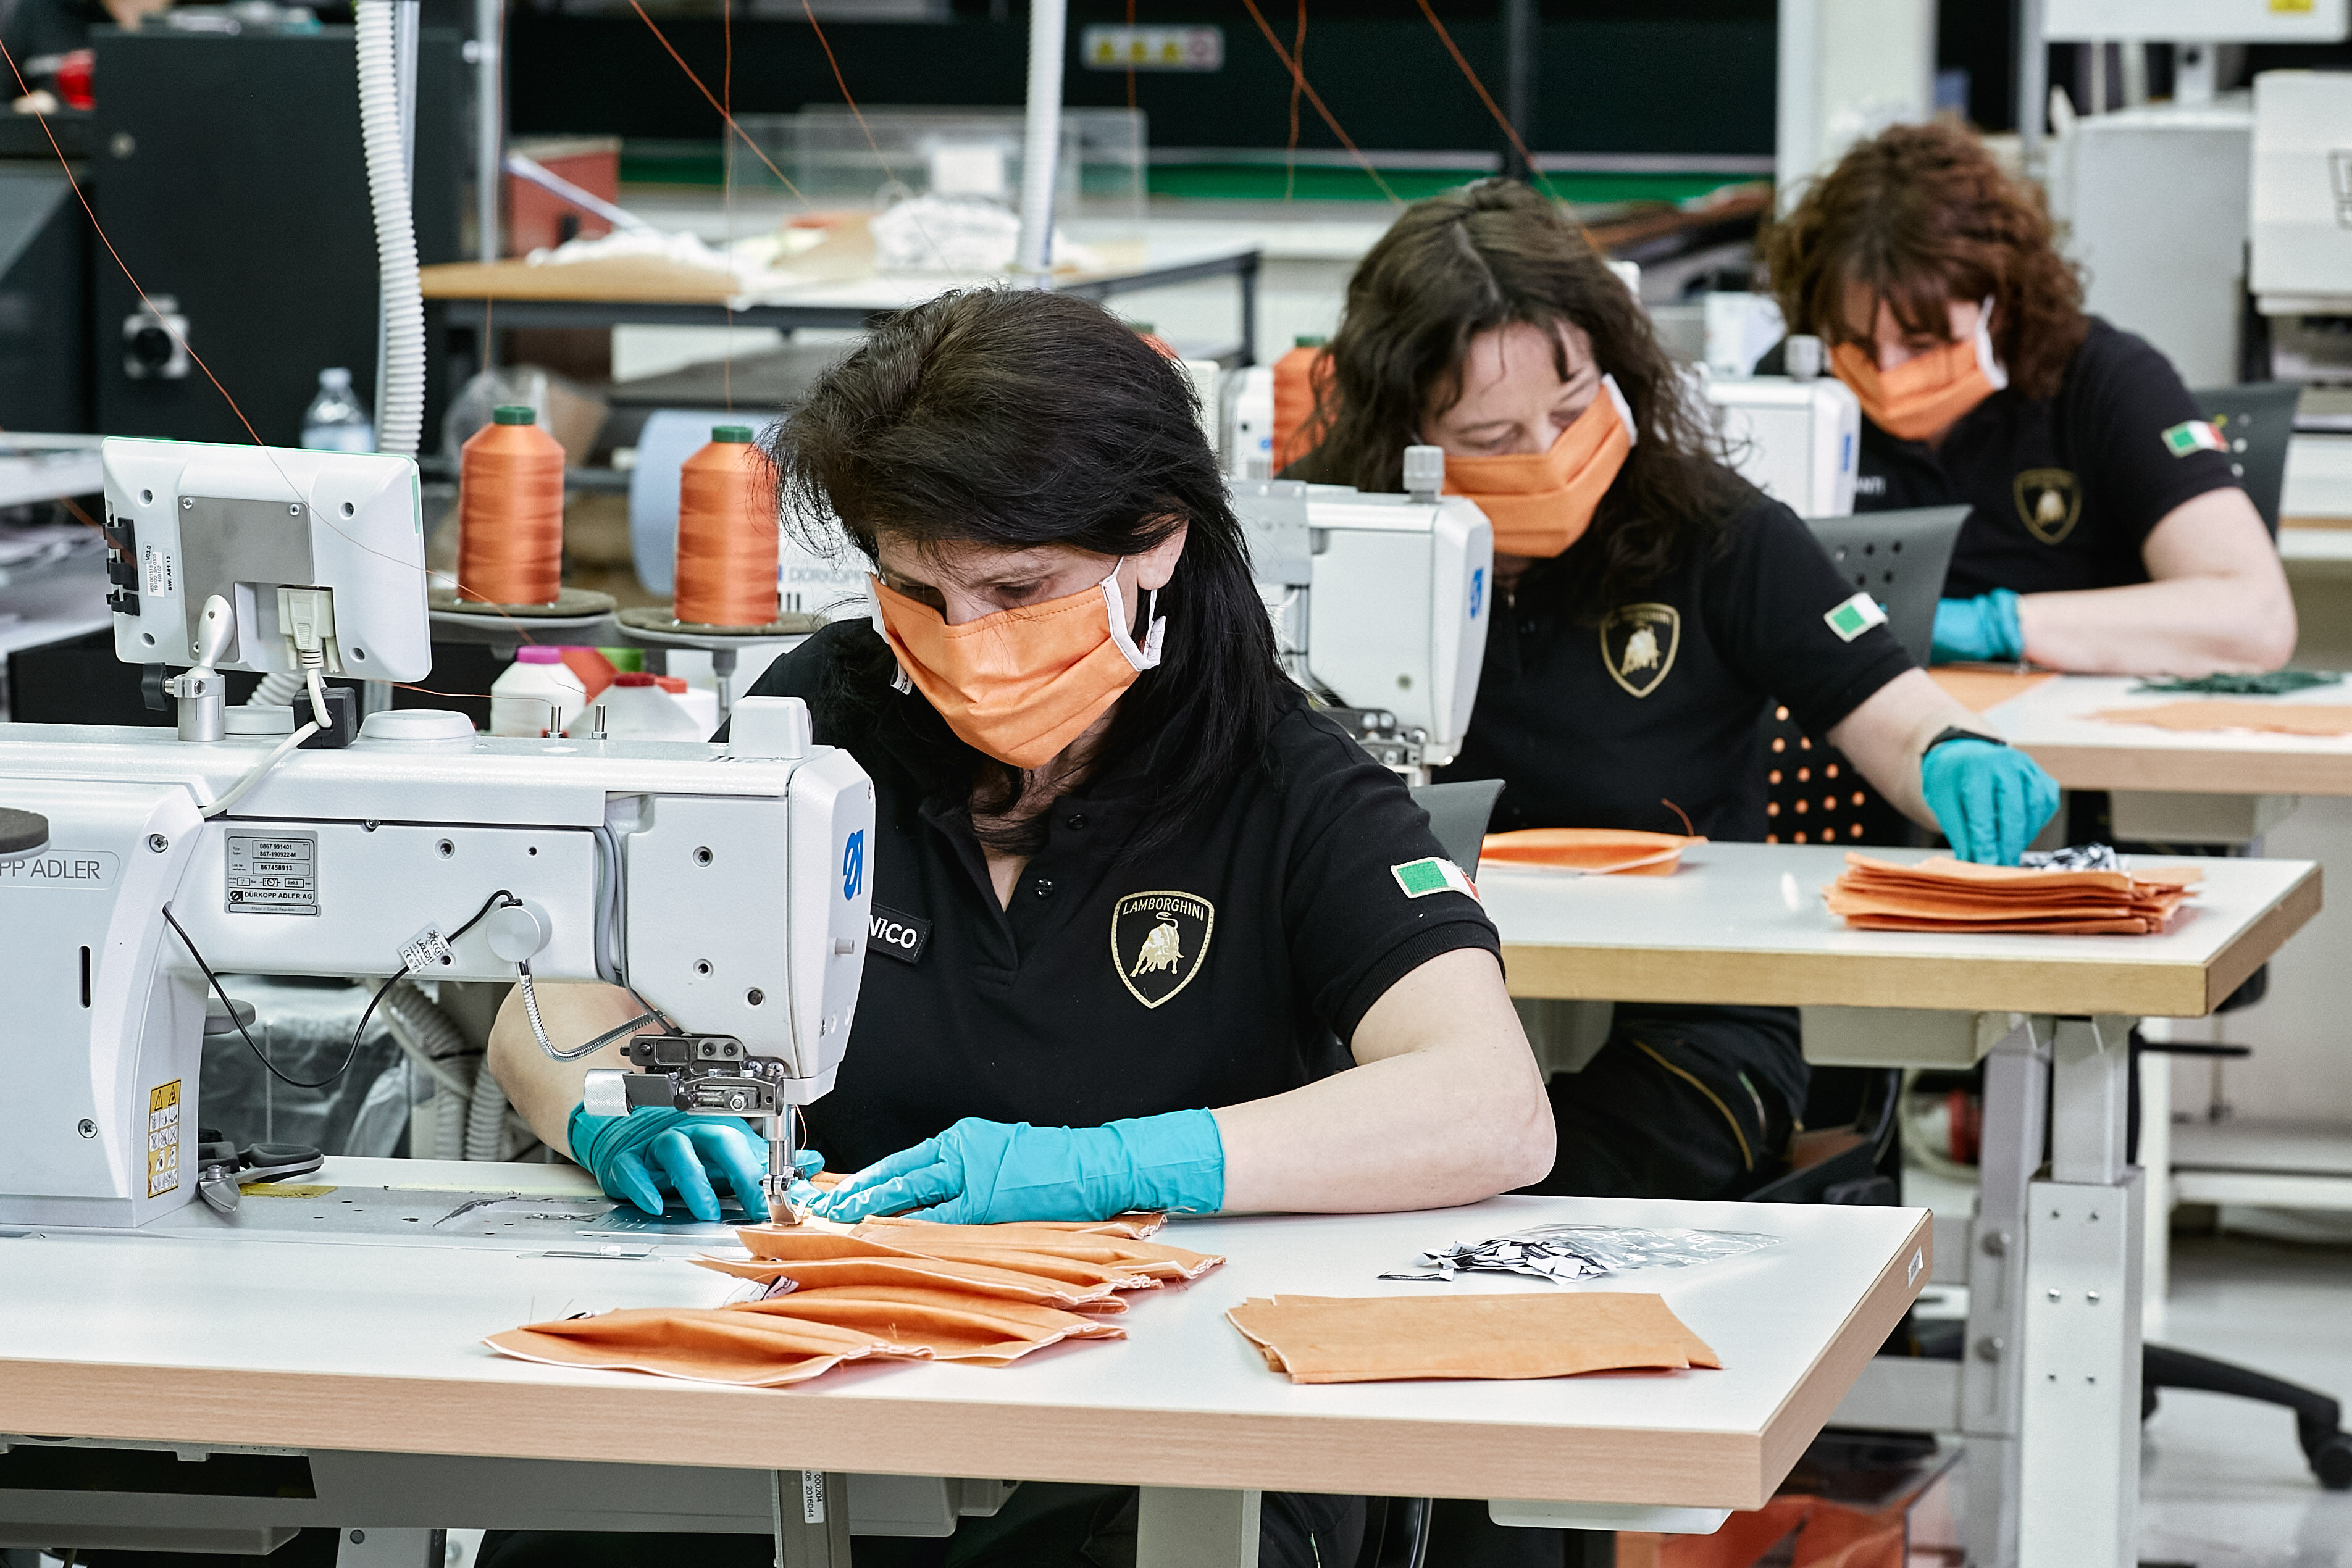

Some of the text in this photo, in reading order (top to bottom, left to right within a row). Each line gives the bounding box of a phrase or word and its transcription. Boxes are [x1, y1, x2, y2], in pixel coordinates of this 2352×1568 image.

[30, 859, 101, 880] ADLER
[1122, 898, 1204, 922] LAMBORGHINI
[806, 1485, 814, 1517] 2016044
[814, 1474, 822, 1503] 000204
